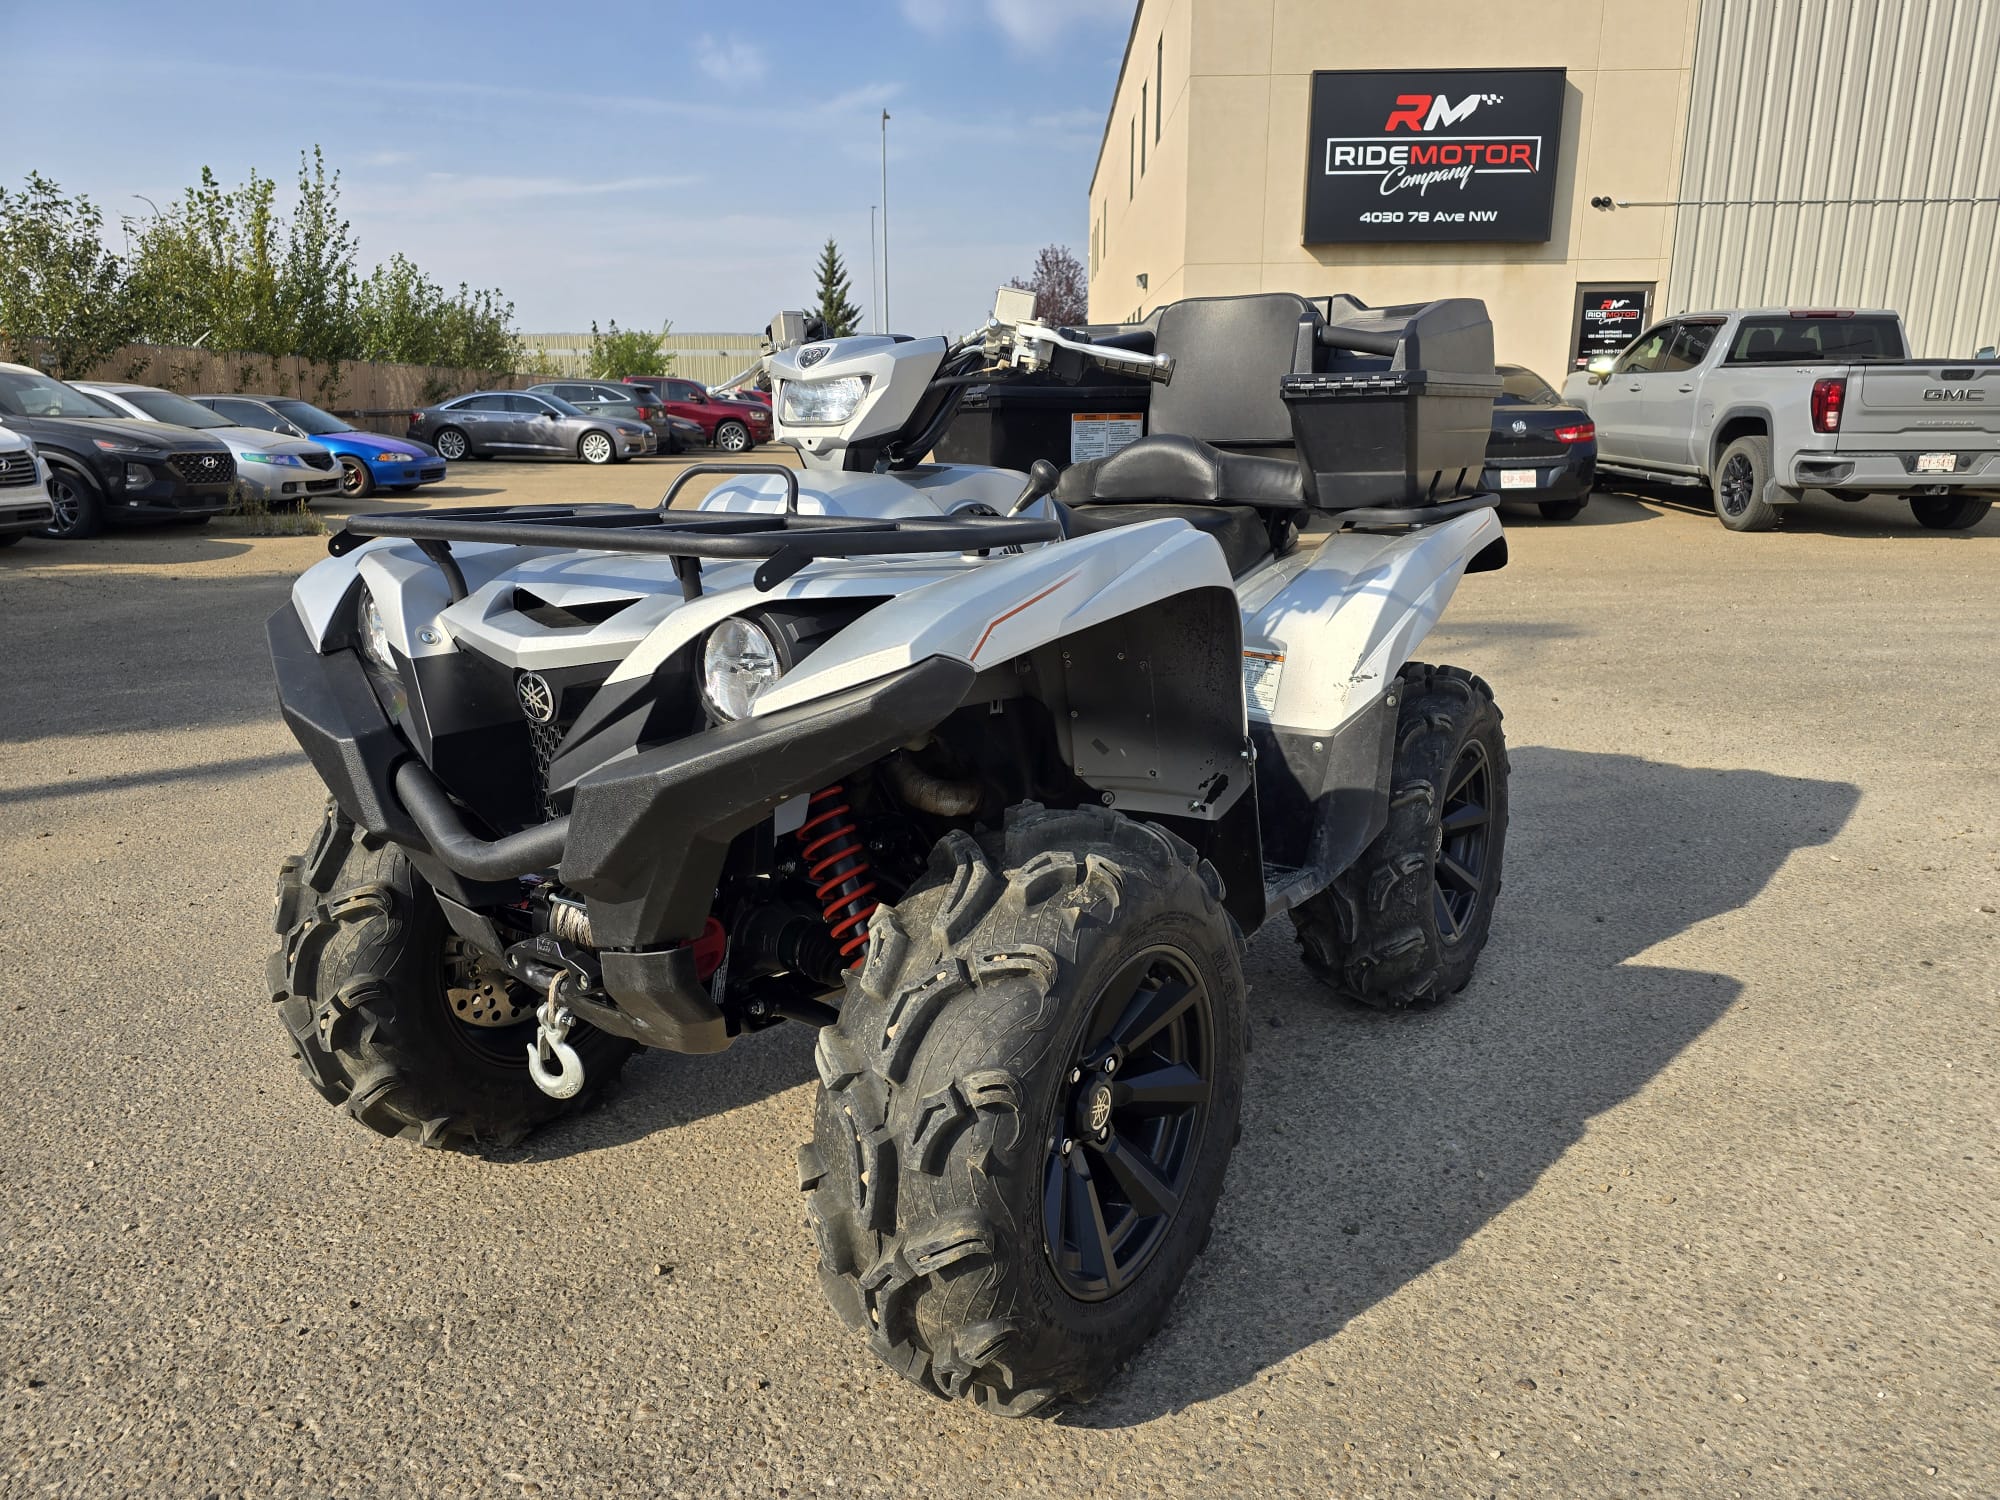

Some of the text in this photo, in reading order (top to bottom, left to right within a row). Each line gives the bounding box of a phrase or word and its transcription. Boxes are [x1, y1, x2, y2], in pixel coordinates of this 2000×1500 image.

[1384, 94, 1481, 132] RM
[1334, 144, 1536, 172] RIDEMOTOR
[1379, 164, 1474, 197] Company
[1359, 211, 1498, 223] 4030 78 Ave NW
[1600, 299, 1624, 310] RM
[1587, 311, 1637, 319] RIDEMOTOR
[1922, 389, 1985, 402] GMC
